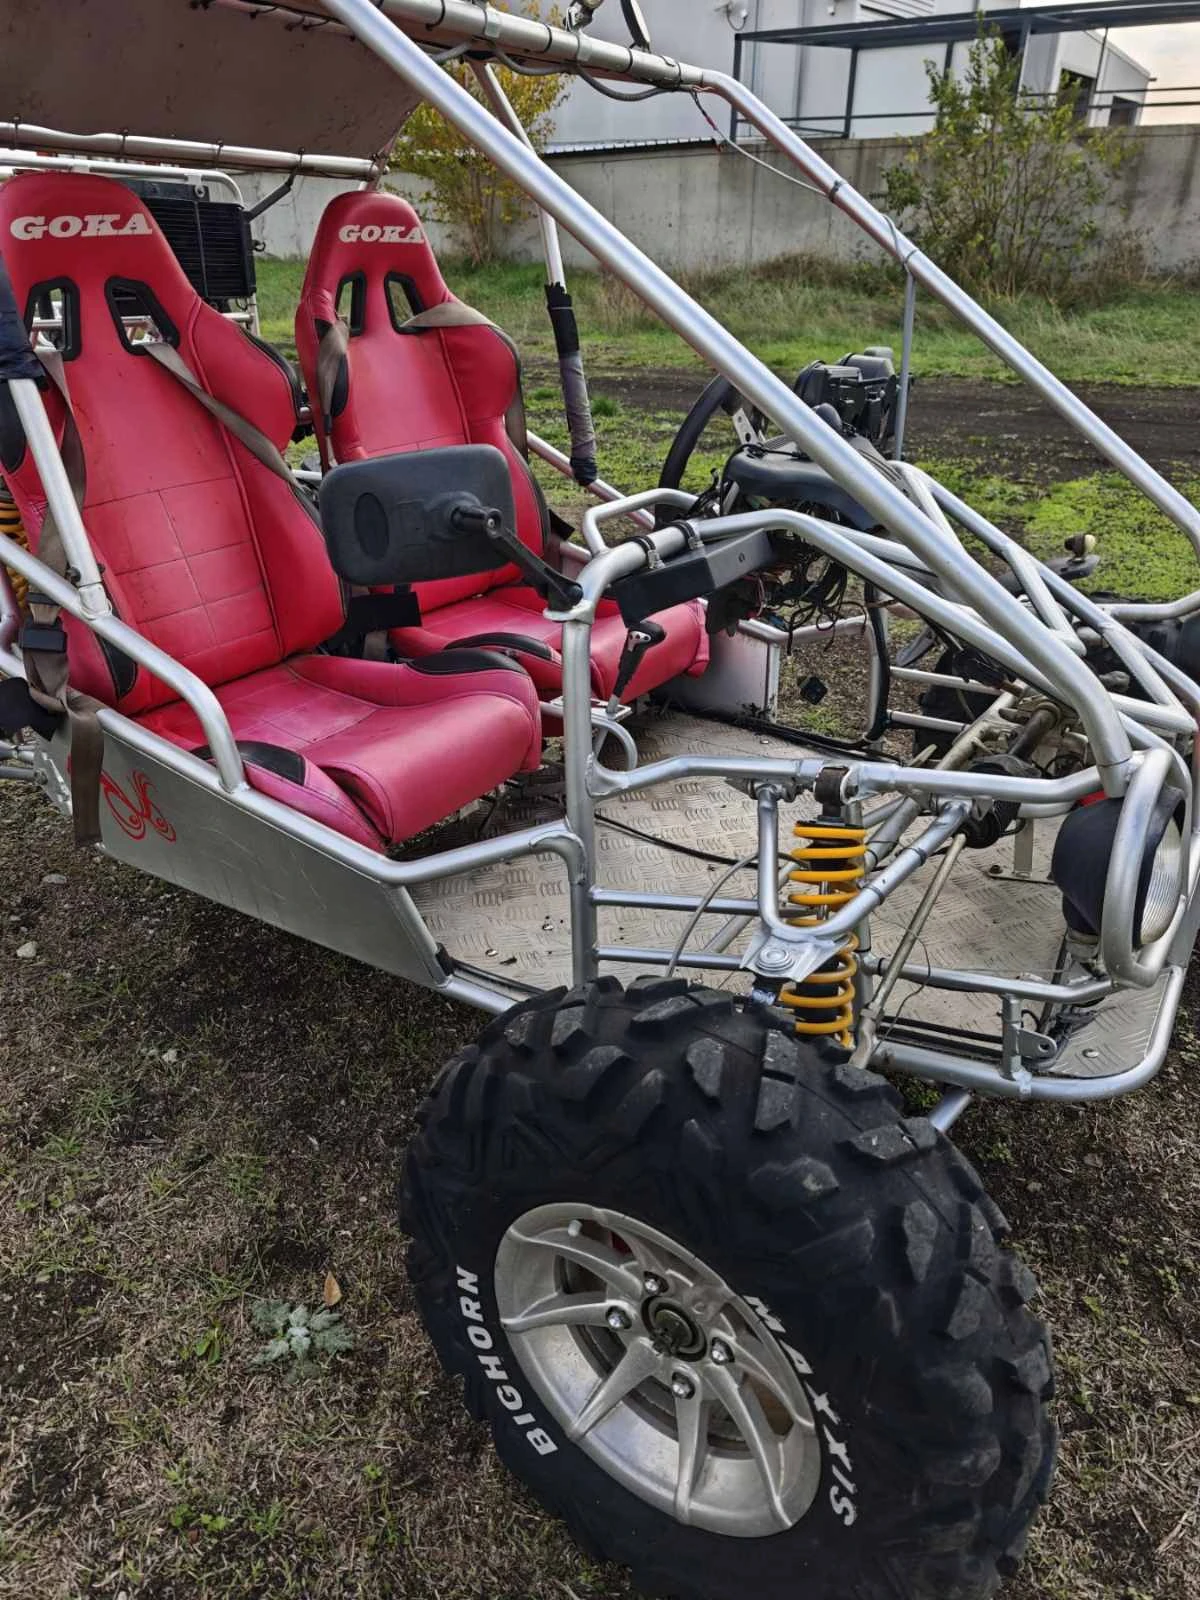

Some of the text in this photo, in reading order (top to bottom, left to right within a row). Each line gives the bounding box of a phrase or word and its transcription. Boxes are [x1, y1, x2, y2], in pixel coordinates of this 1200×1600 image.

[10, 213, 153, 241] GOKA
[338, 224, 425, 244] GOKA
[456, 1264, 559, 1456] BIGHORN
[743, 1295, 858, 1526] MAXXIS
